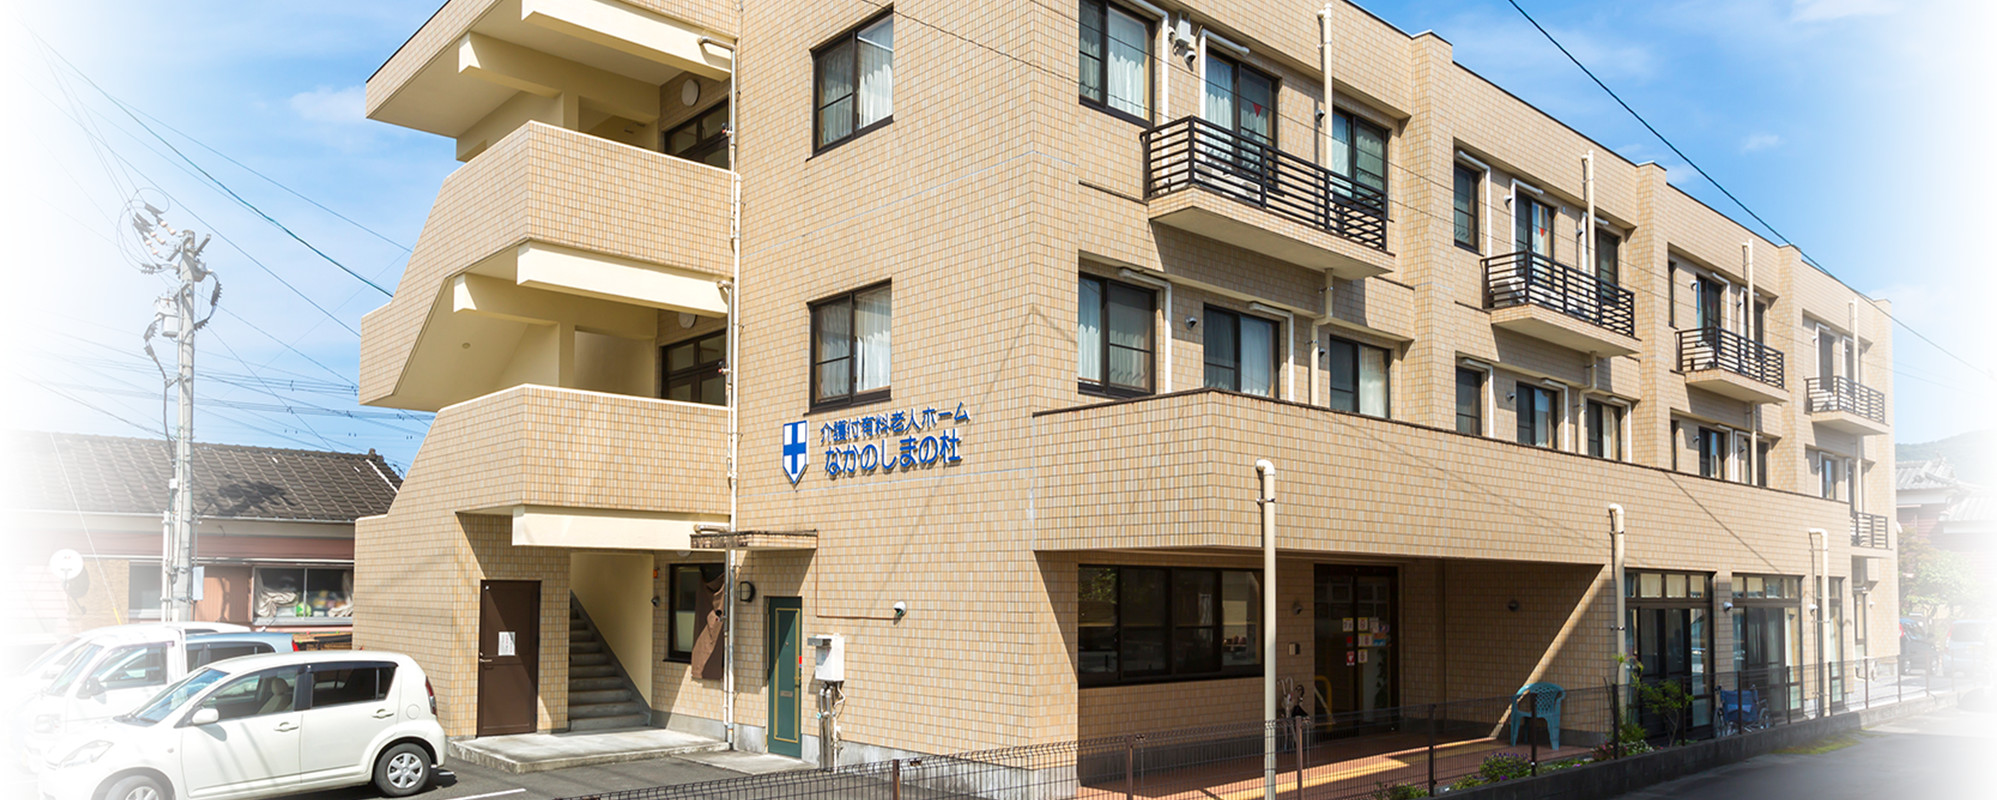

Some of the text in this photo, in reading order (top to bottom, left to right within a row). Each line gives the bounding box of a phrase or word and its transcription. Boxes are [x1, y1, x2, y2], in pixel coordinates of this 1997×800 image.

[820, 402, 970, 443] 介護付有料老人ホーム
[825, 428, 961, 475] なかのしまの杜
